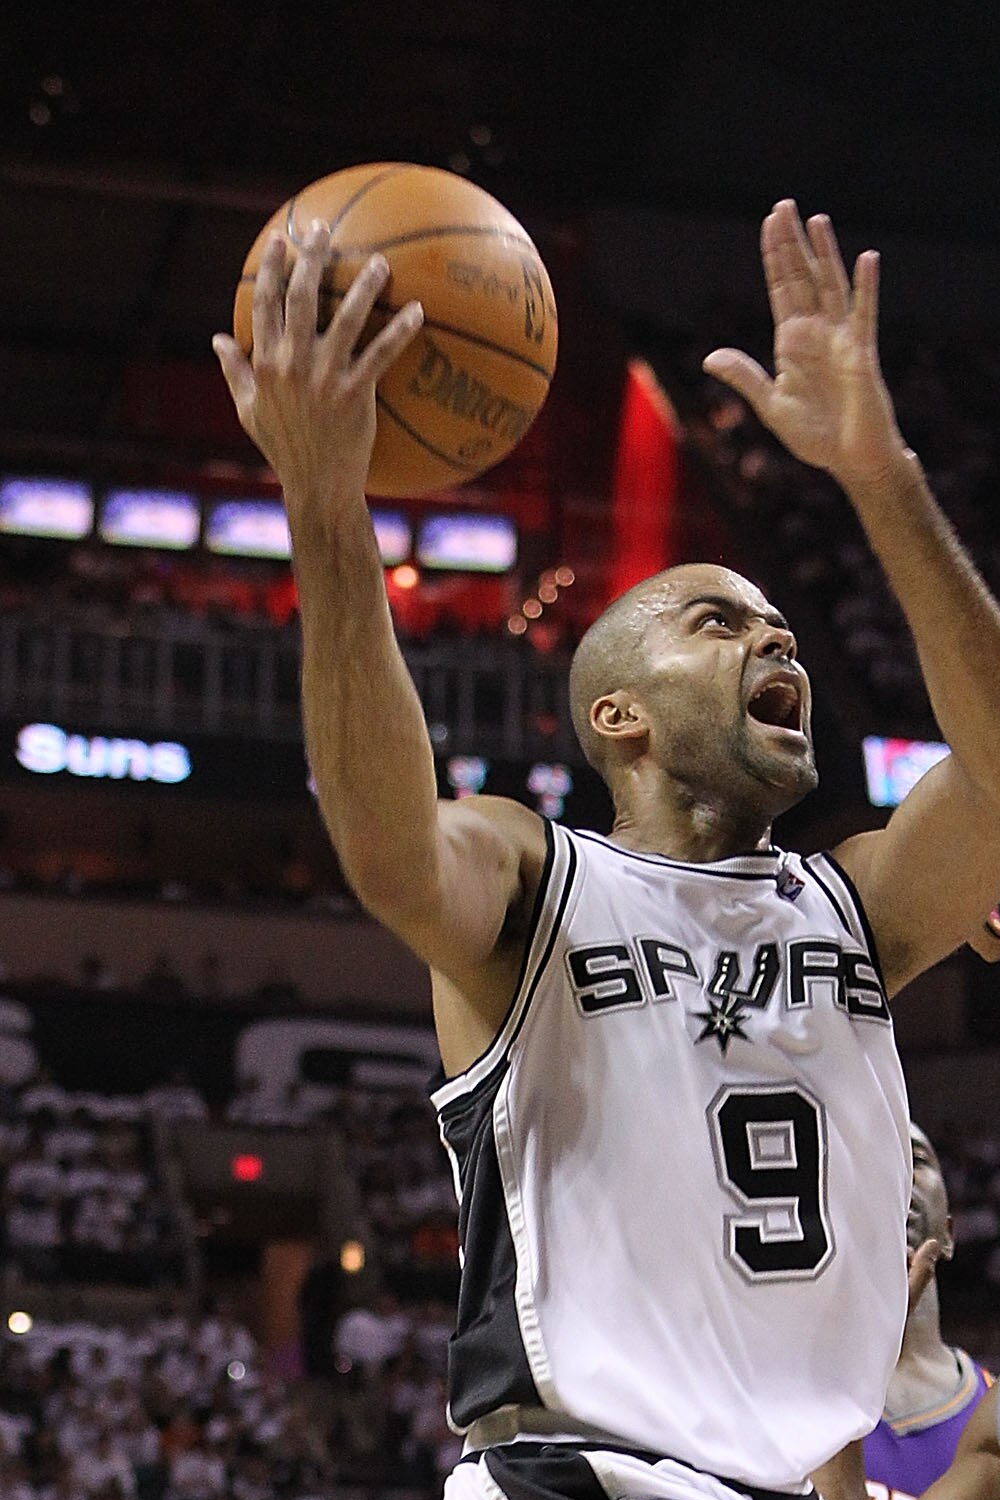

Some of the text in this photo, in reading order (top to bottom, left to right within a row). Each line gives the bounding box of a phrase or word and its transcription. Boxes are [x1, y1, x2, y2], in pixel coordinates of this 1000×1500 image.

[15, 722, 192, 783] Suns
[565, 934, 894, 1025] SPURS
[705, 1082, 838, 1285] 9
